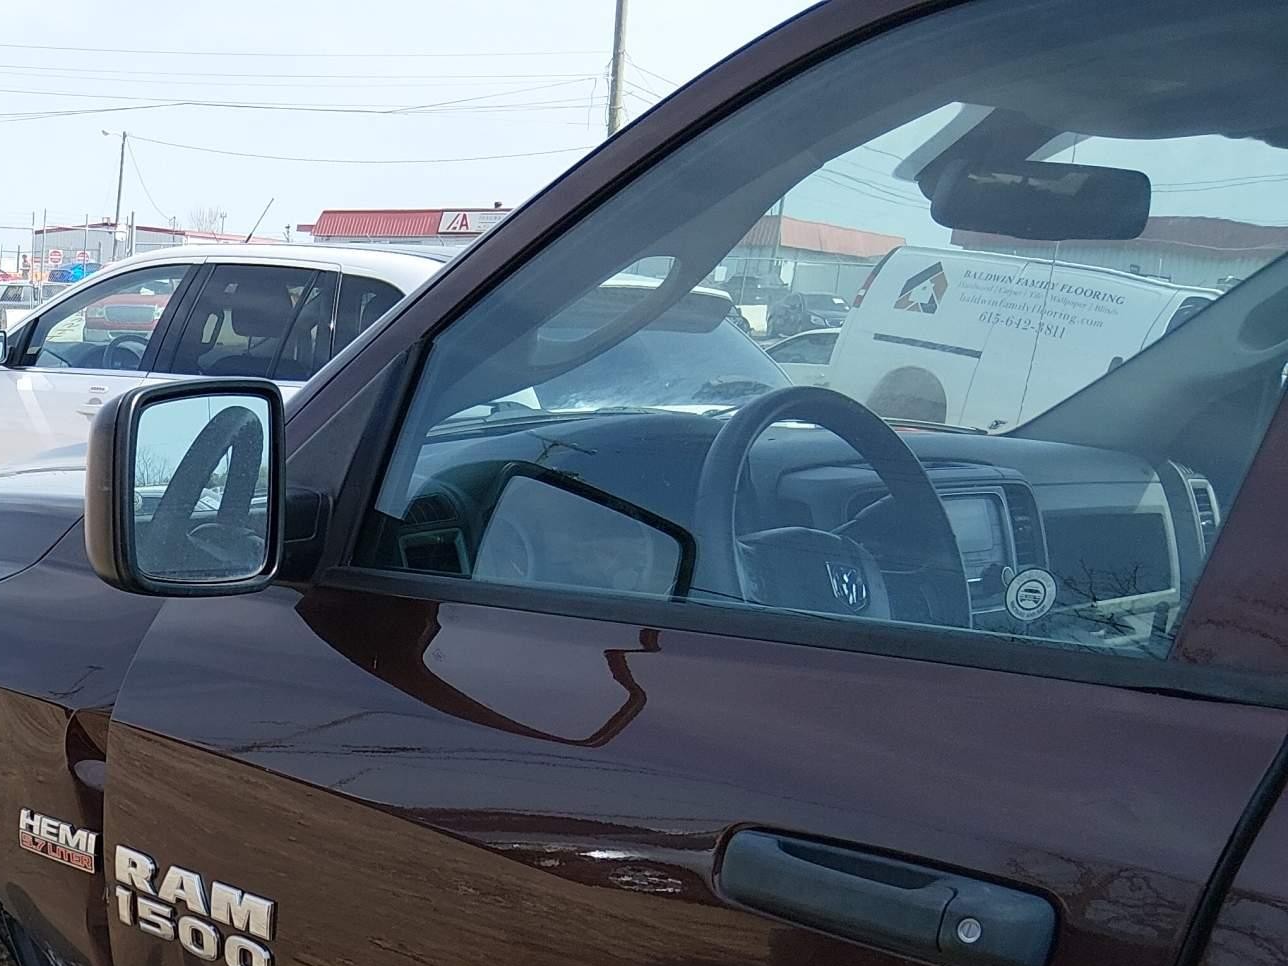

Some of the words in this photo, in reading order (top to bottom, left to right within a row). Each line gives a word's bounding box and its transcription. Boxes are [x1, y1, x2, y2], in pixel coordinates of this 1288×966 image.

[963, 269, 1013, 285] BALDWIN
[1015, 276, 1059, 291] FAMILY
[1059, 283, 1127, 306] FLOORING
[978, 310, 1066, 339] 615-642-3811
[19, 807, 98, 855] HEMI
[22, 833, 46, 852] 5.7
[47, 842, 92, 870] LITER
[115, 843, 278, 941] RAM
